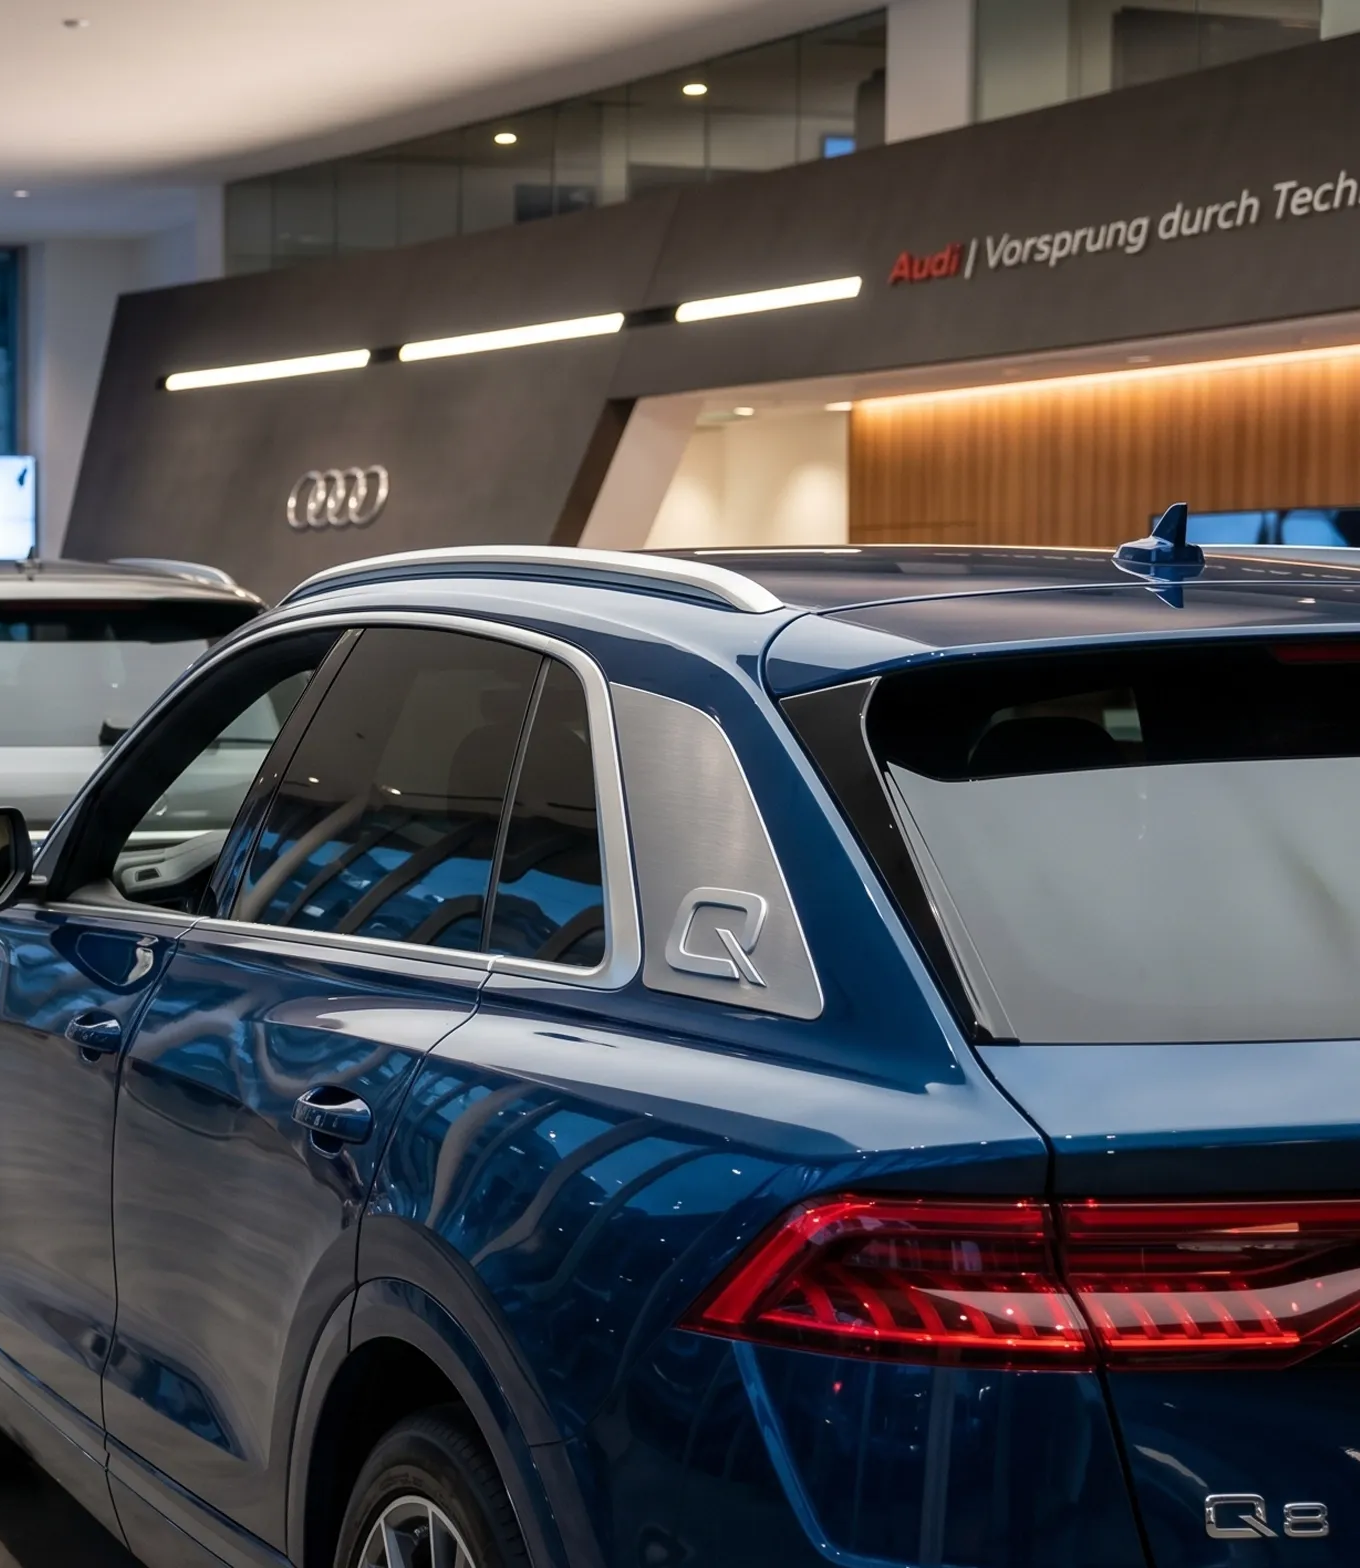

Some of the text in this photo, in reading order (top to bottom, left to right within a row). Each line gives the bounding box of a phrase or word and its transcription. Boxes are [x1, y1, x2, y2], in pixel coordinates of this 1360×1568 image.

[888, 242, 962, 284] Audi
[986, 214, 1150, 266] Vorsprung
[1158, 188, 1260, 240] durch
[1273, 169, 1360, 220] Tech
[664, 886, 767, 988] Q
[1205, 1493, 1330, 1538] Q8
